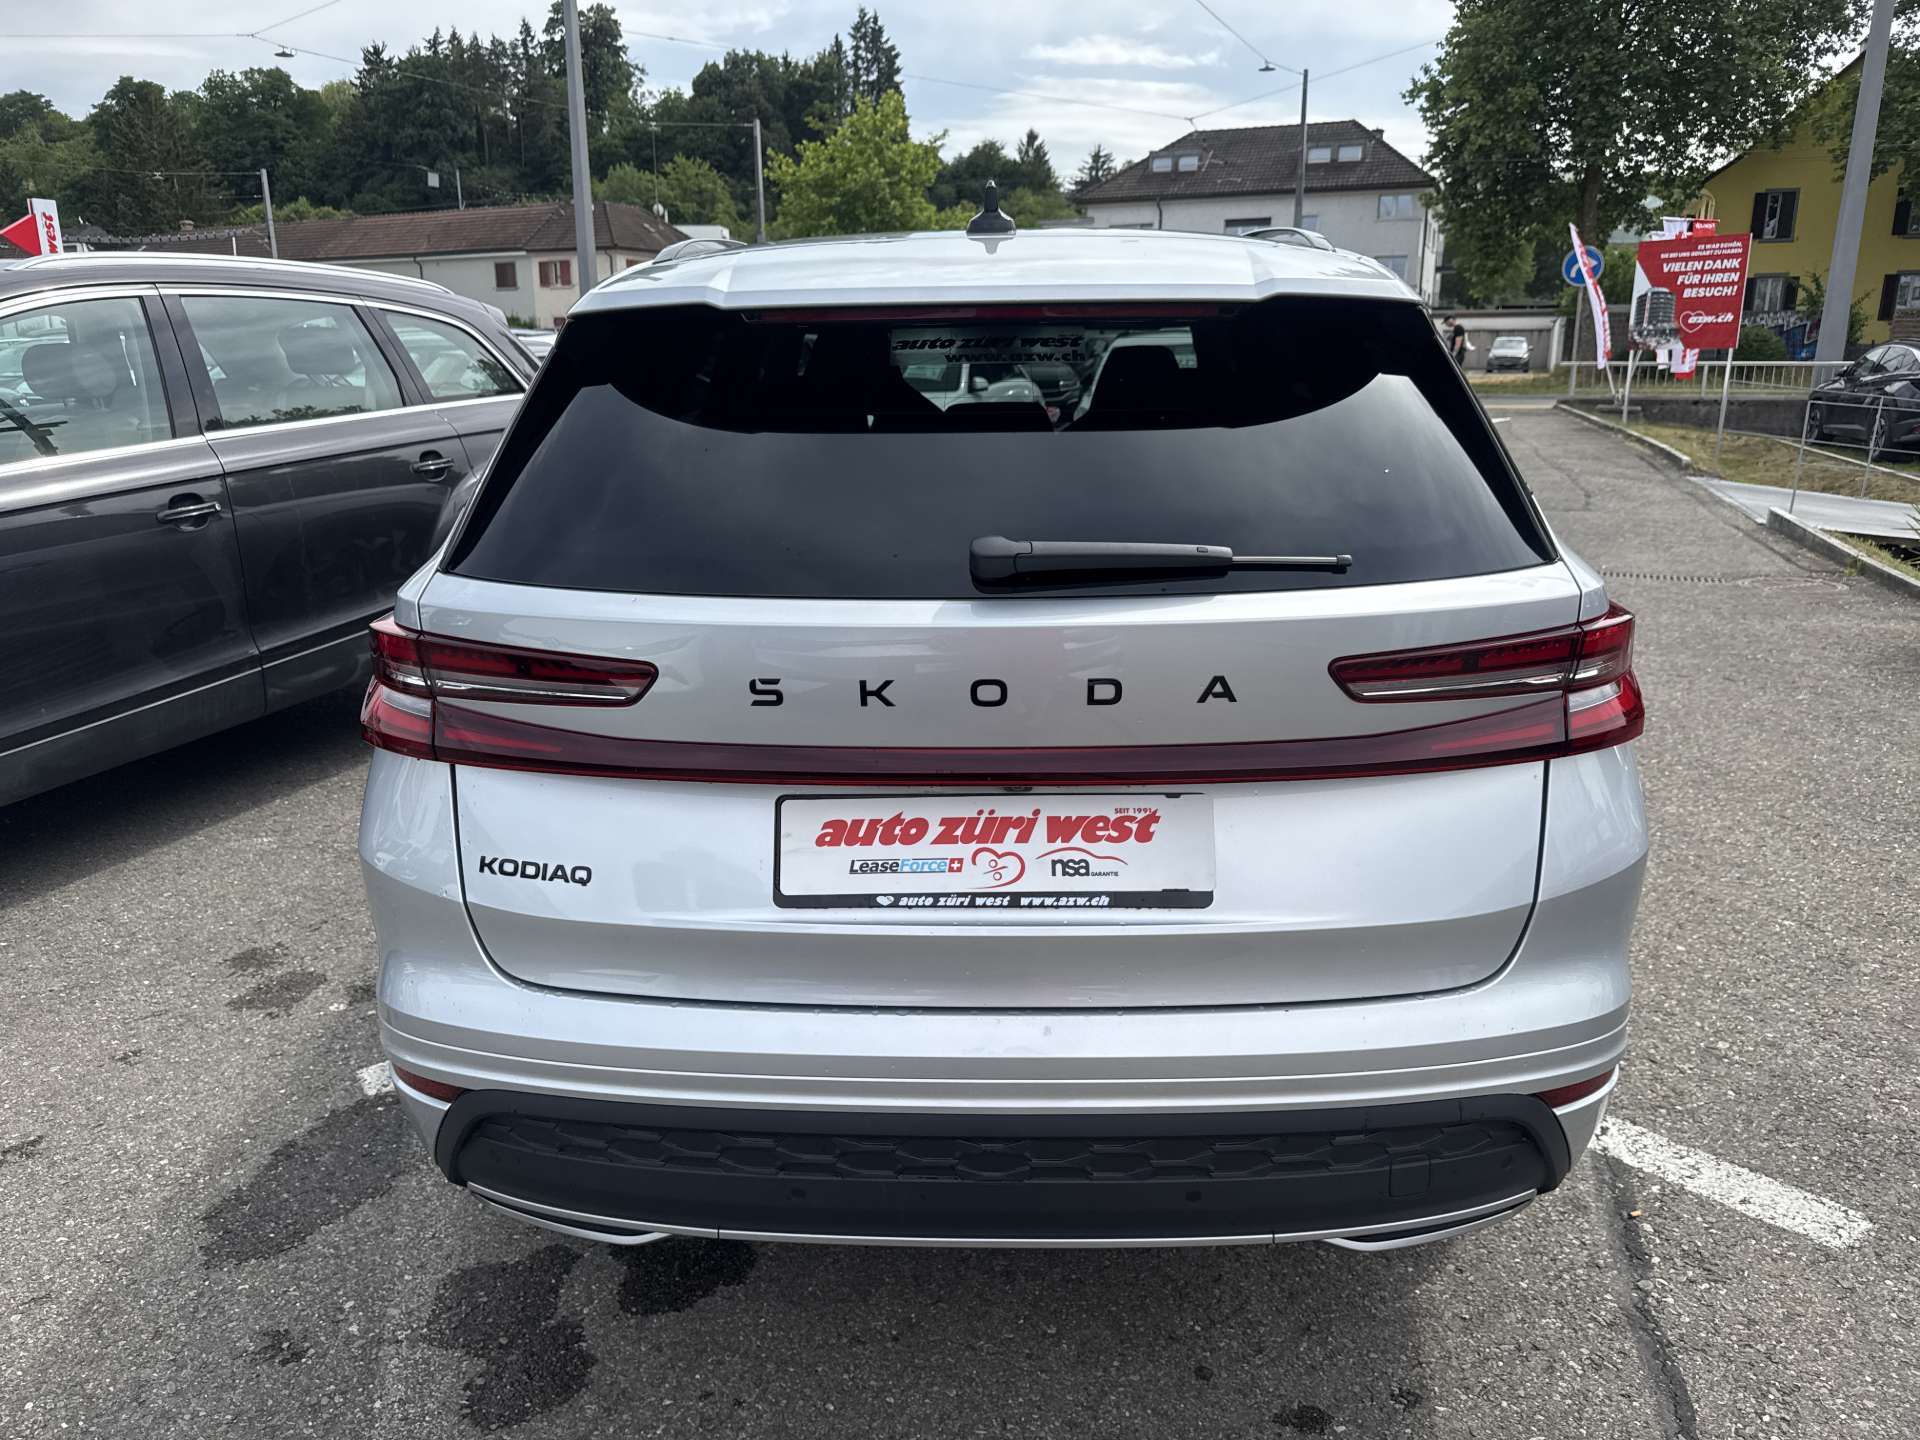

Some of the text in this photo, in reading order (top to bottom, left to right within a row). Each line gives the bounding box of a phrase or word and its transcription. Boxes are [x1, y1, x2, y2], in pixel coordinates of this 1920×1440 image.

[1662, 258, 1742, 273] VIELEN DANK
[1676, 272, 1740, 285] FÜR IHREN
[1682, 285, 1738, 298] BESUCH!
[1020, 335, 1085, 348] west
[815, 808, 1161, 847] auto züri west
[479, 856, 592, 886] KODIAQ
[850, 859, 947, 873] LeaseForce
[1051, 858, 1090, 877] nsa
[898, 894, 1110, 906] auto züri west www.azw.ch
